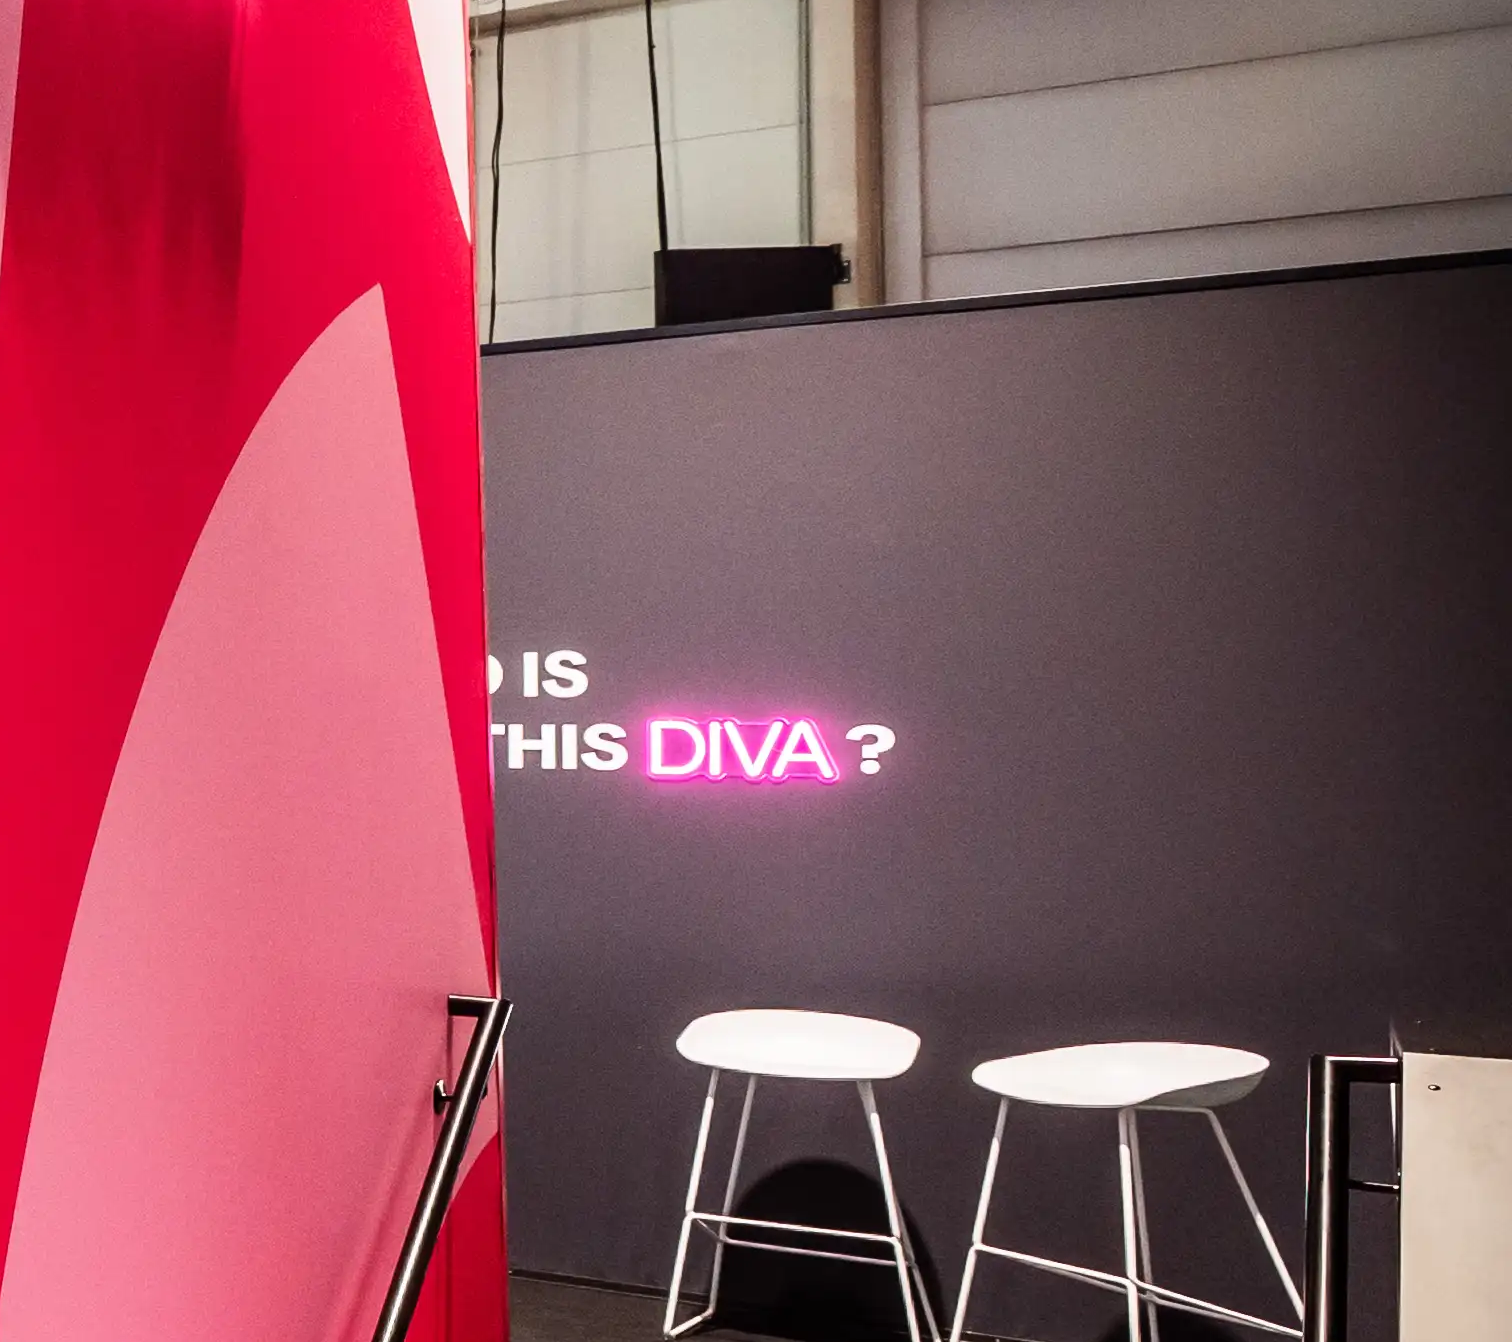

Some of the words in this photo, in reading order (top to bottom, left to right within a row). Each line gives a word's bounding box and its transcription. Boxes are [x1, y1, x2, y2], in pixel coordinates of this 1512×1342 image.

[522, 649, 589, 698] IS
[648, 718, 838, 781] DIVA
[845, 723, 896, 775] ?
